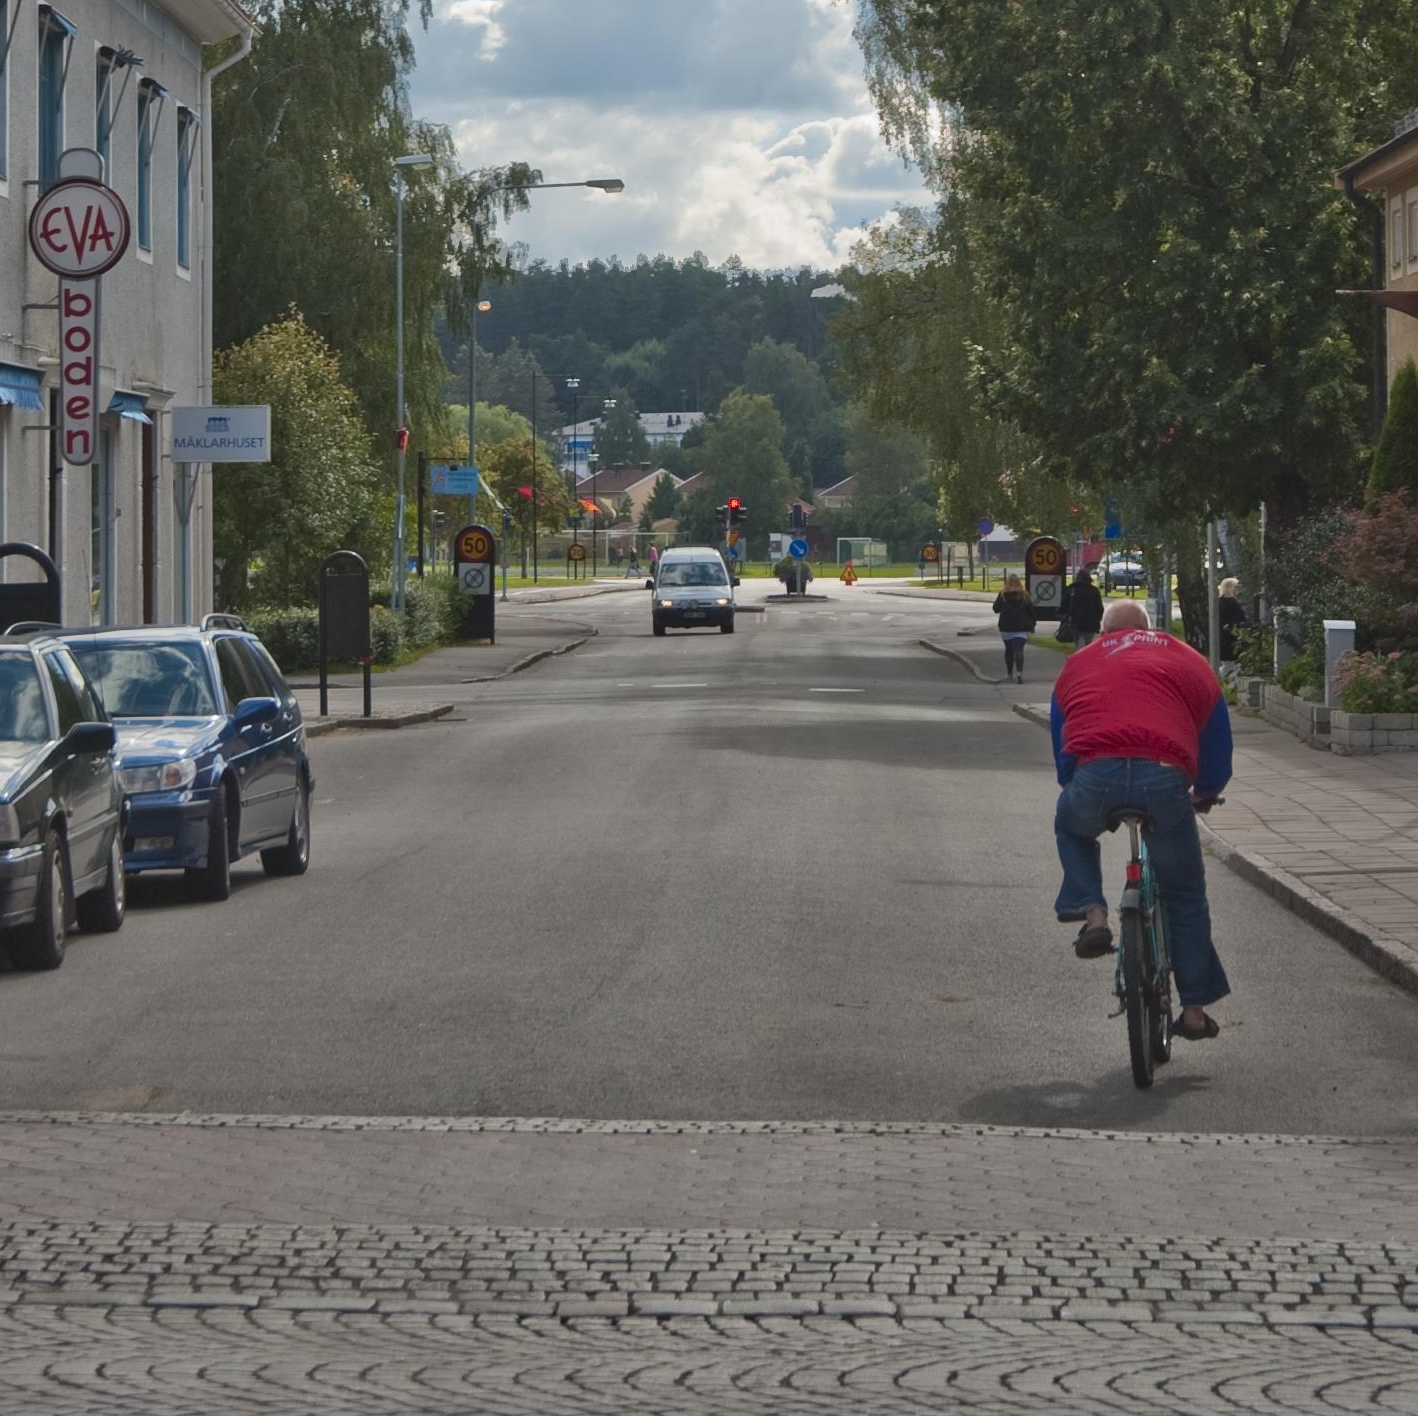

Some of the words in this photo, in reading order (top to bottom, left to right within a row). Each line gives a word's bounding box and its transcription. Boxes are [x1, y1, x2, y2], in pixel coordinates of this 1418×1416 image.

[40, 204, 115, 266] EVA
[63, 288, 93, 455] boden
[173, 436, 265, 449] MÄKLARHUSET
[464, 537, 486, 554] 50
[1035, 549, 1057, 566] 50
